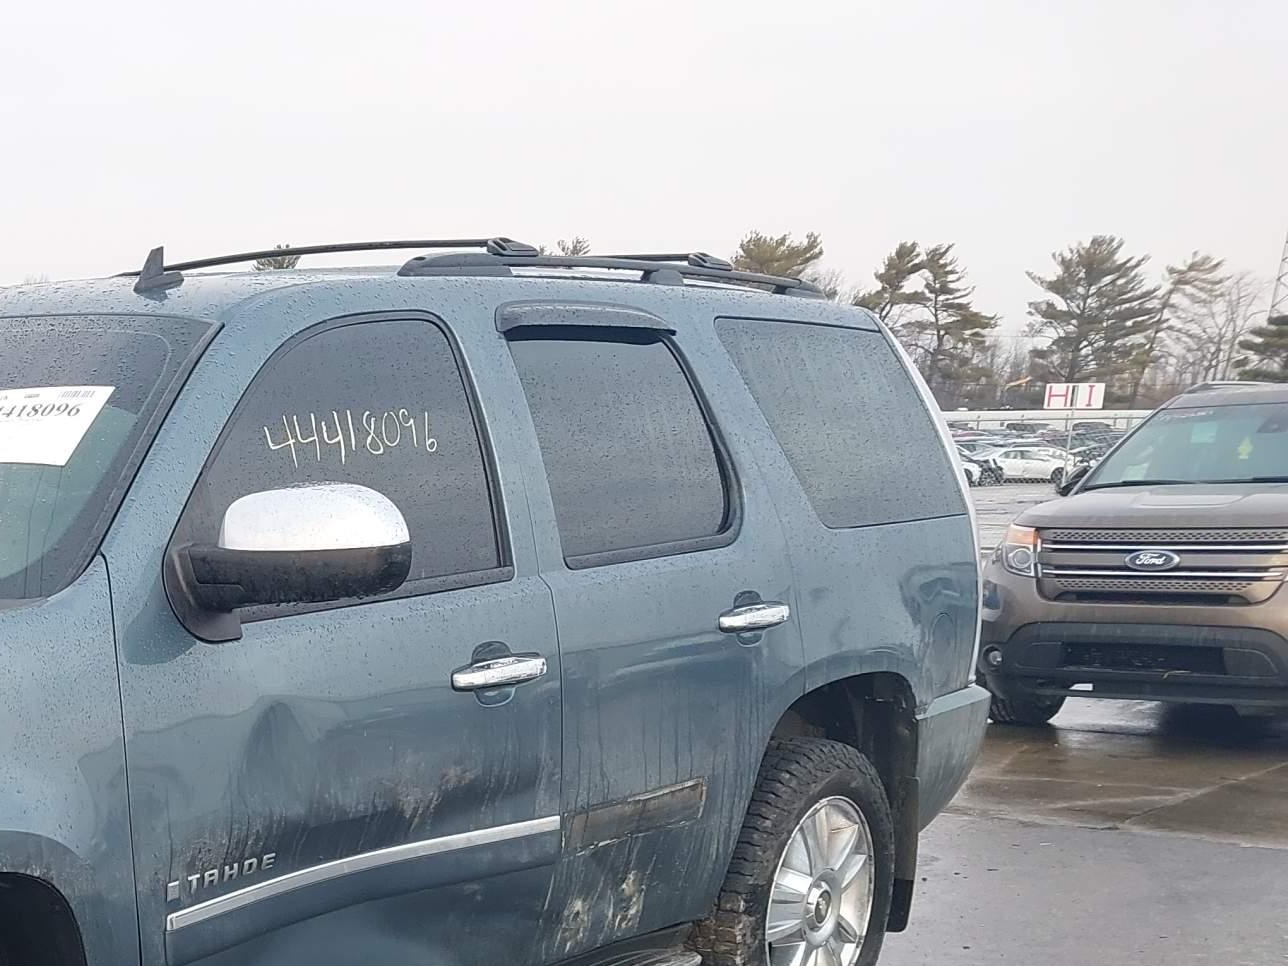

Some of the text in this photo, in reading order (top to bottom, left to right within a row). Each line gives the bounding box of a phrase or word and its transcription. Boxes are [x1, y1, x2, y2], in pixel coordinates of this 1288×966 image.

[264, 408, 438, 469] 44418096
[1135, 553, 1166, 564] Ford
[187, 853, 276, 894] TAHOE
